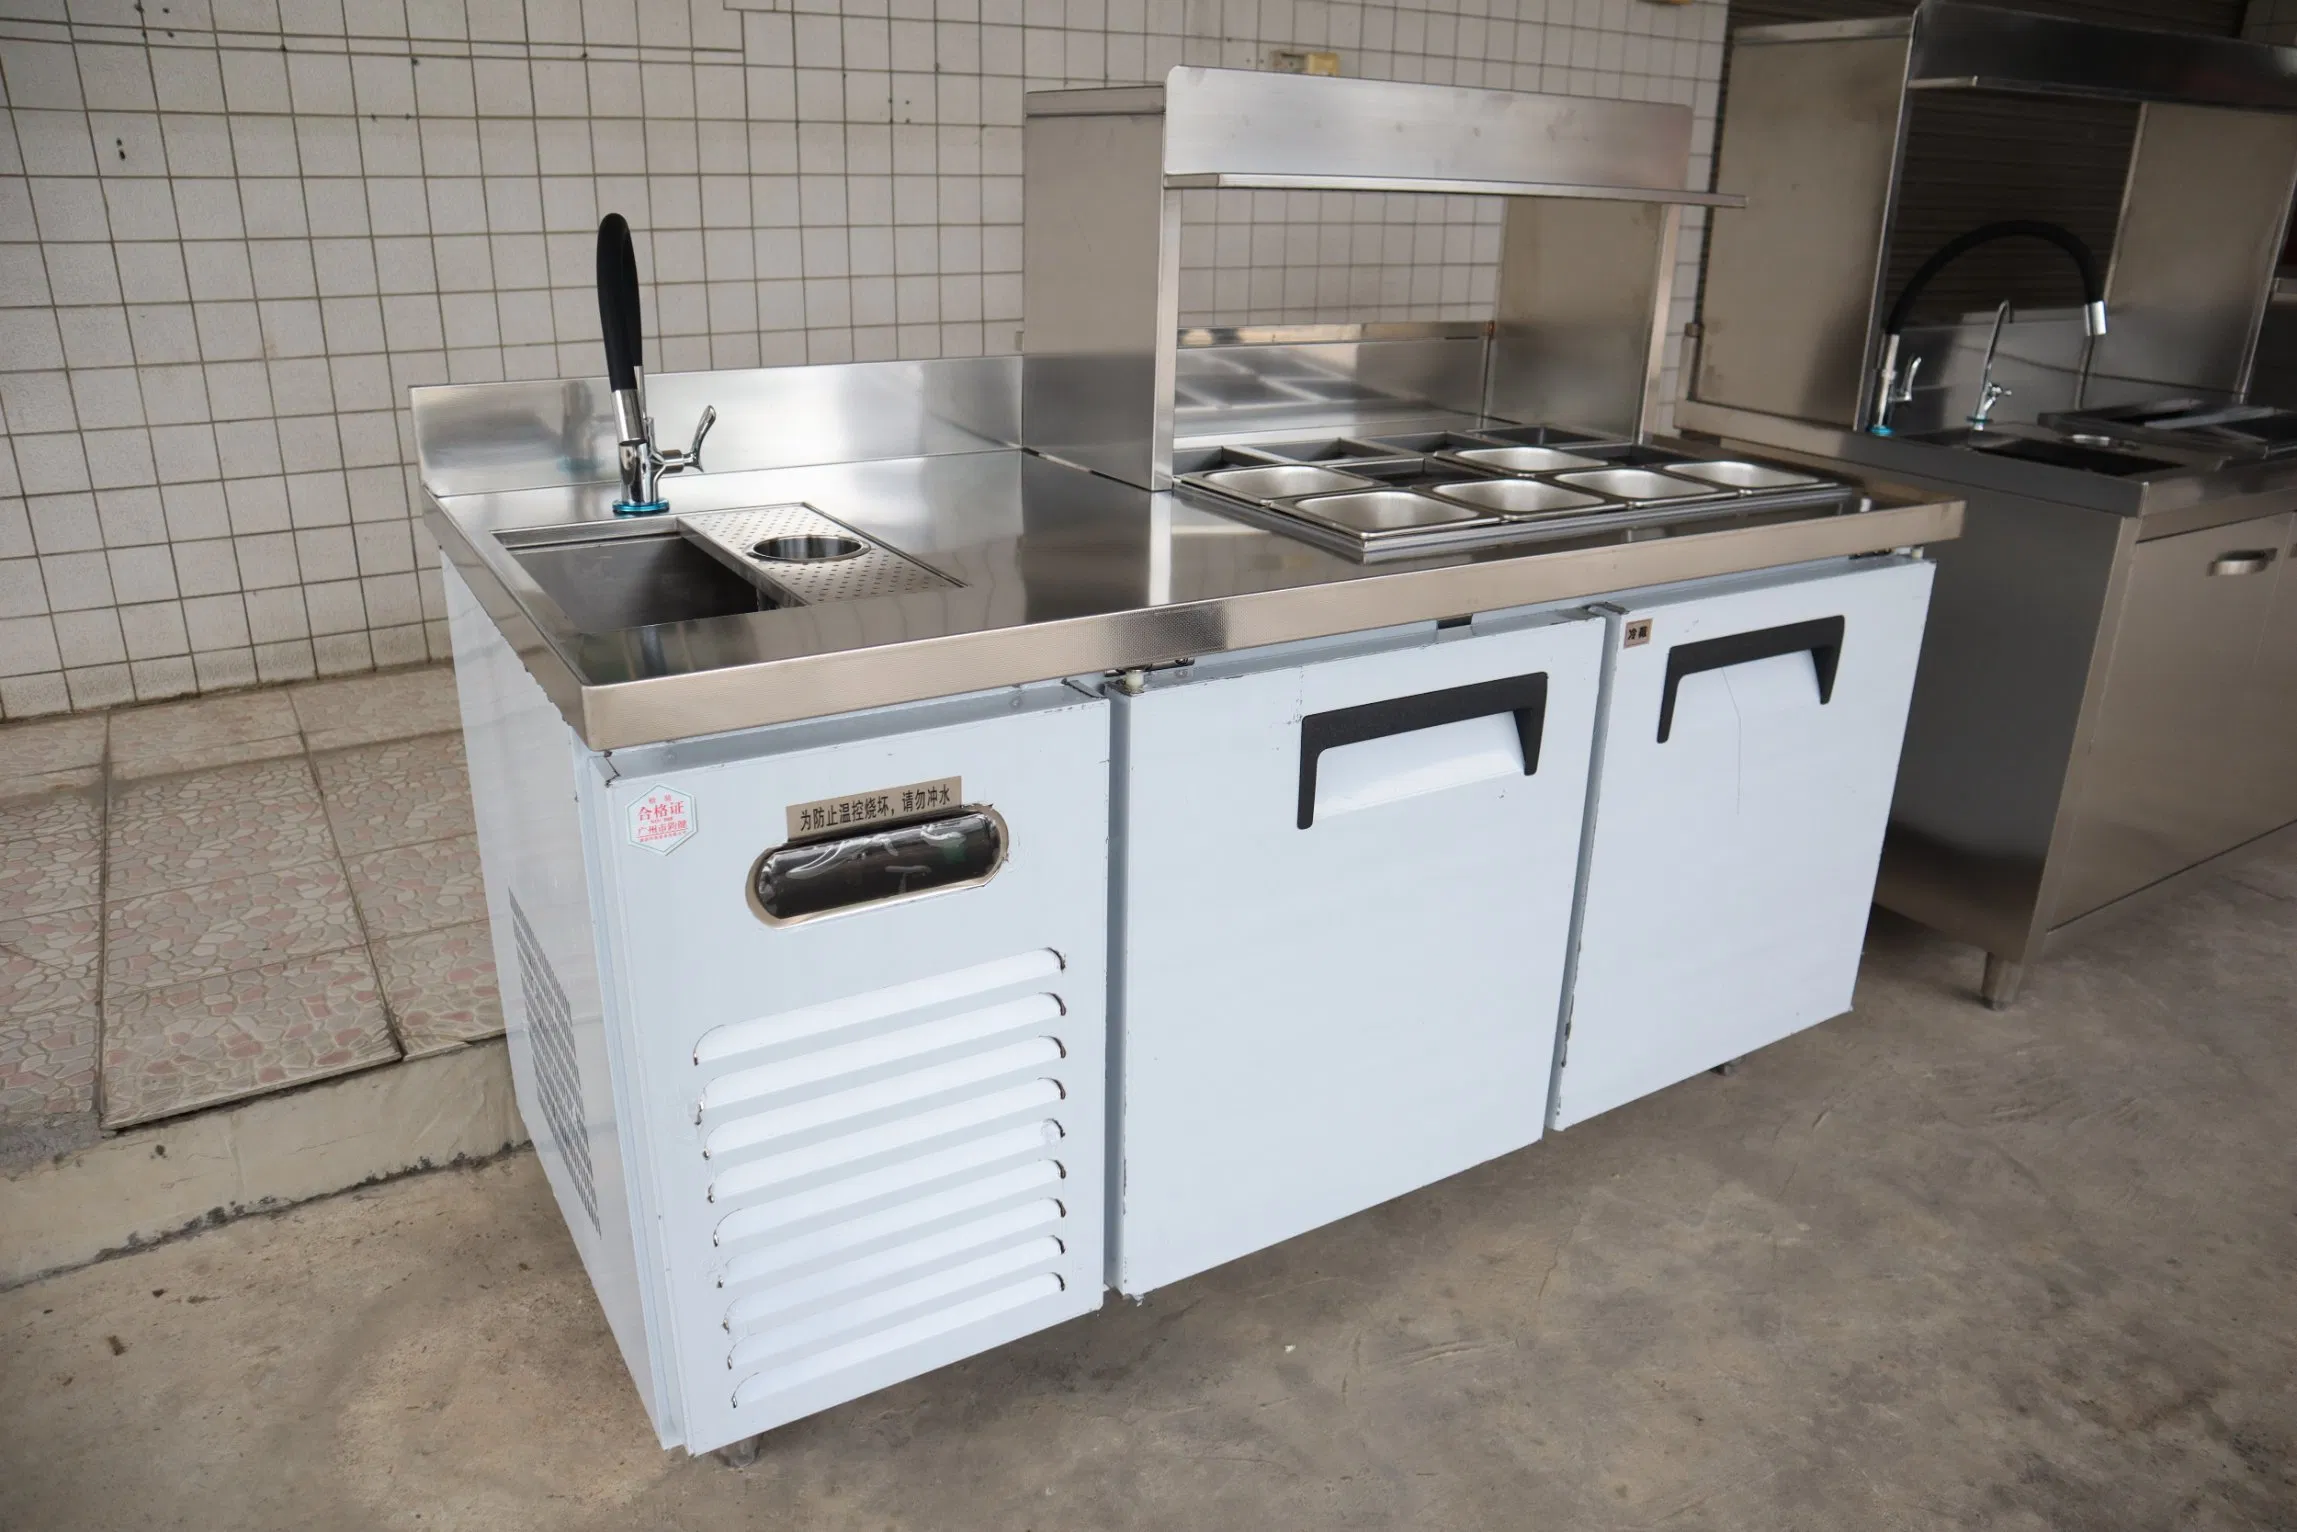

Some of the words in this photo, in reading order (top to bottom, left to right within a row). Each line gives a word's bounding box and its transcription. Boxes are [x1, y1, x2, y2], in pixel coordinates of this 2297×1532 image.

[639, 800, 684, 821] 合格证
[799, 783, 950, 832] 为防止温控烧坏，请勿冲水
